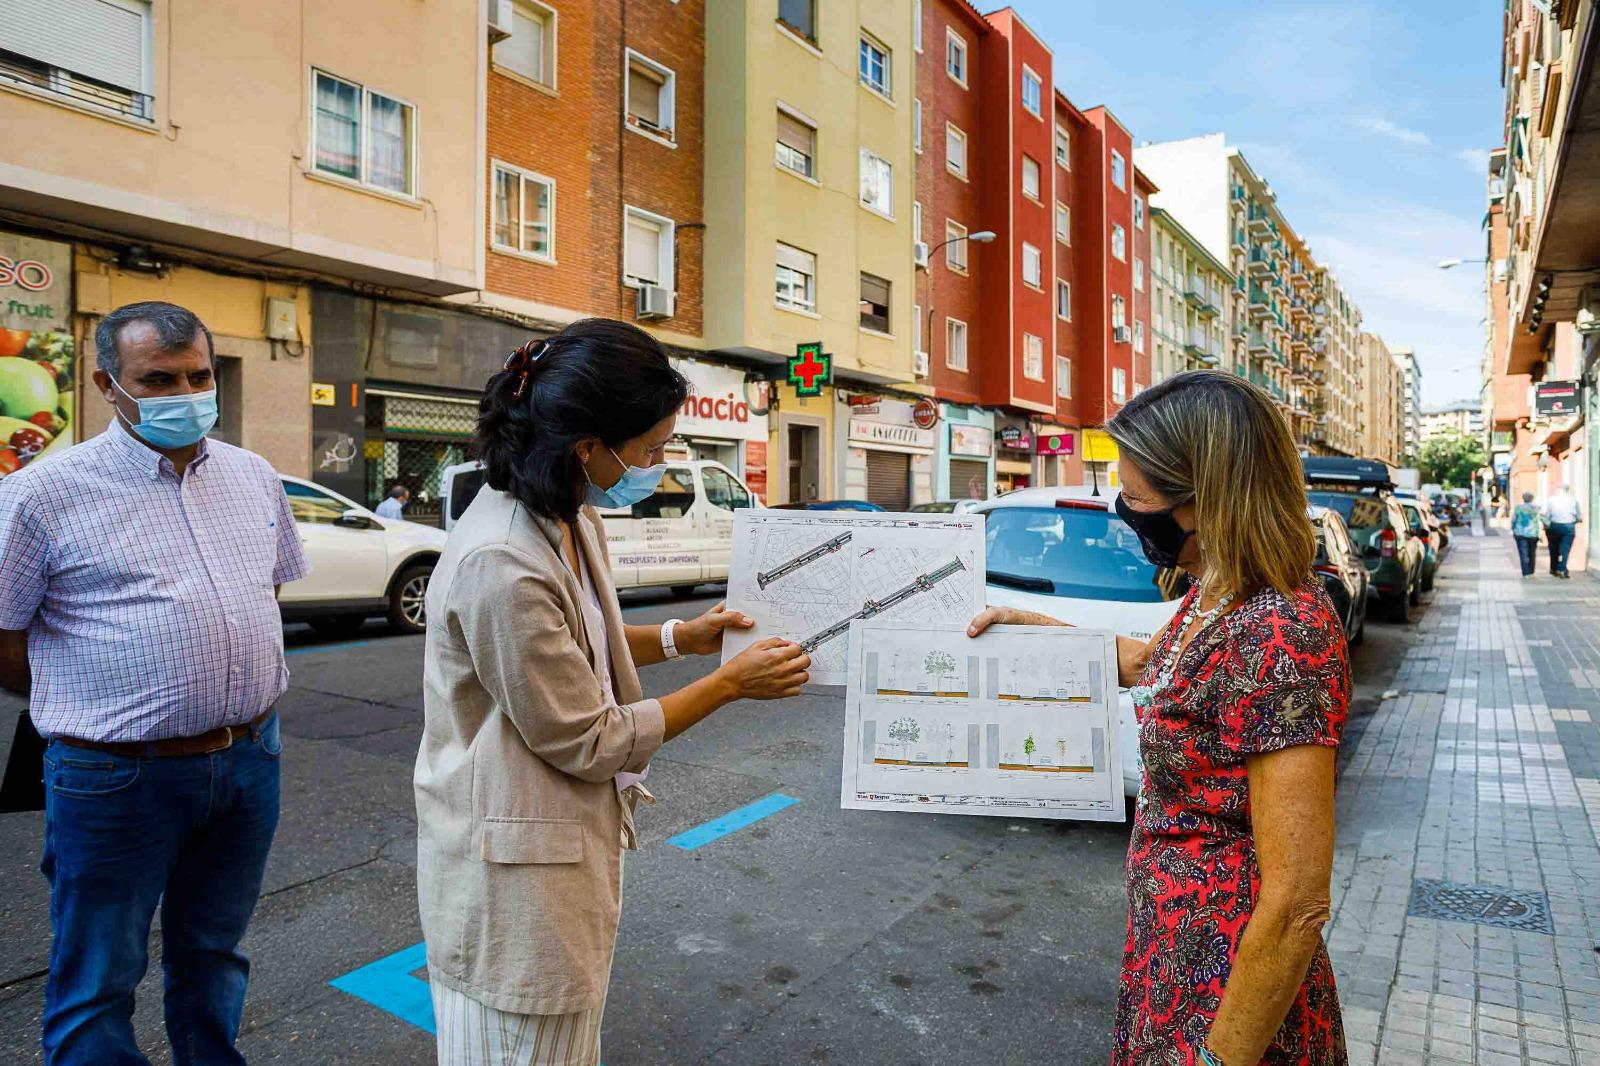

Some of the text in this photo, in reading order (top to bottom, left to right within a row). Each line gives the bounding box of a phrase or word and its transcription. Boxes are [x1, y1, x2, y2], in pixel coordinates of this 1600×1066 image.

[8, 300, 53, 319] fruit
[676, 393, 749, 422] macia
[618, 556, 657, 565] PRESUPUESTO
[668, 554, 700, 563] COMPROMISO
